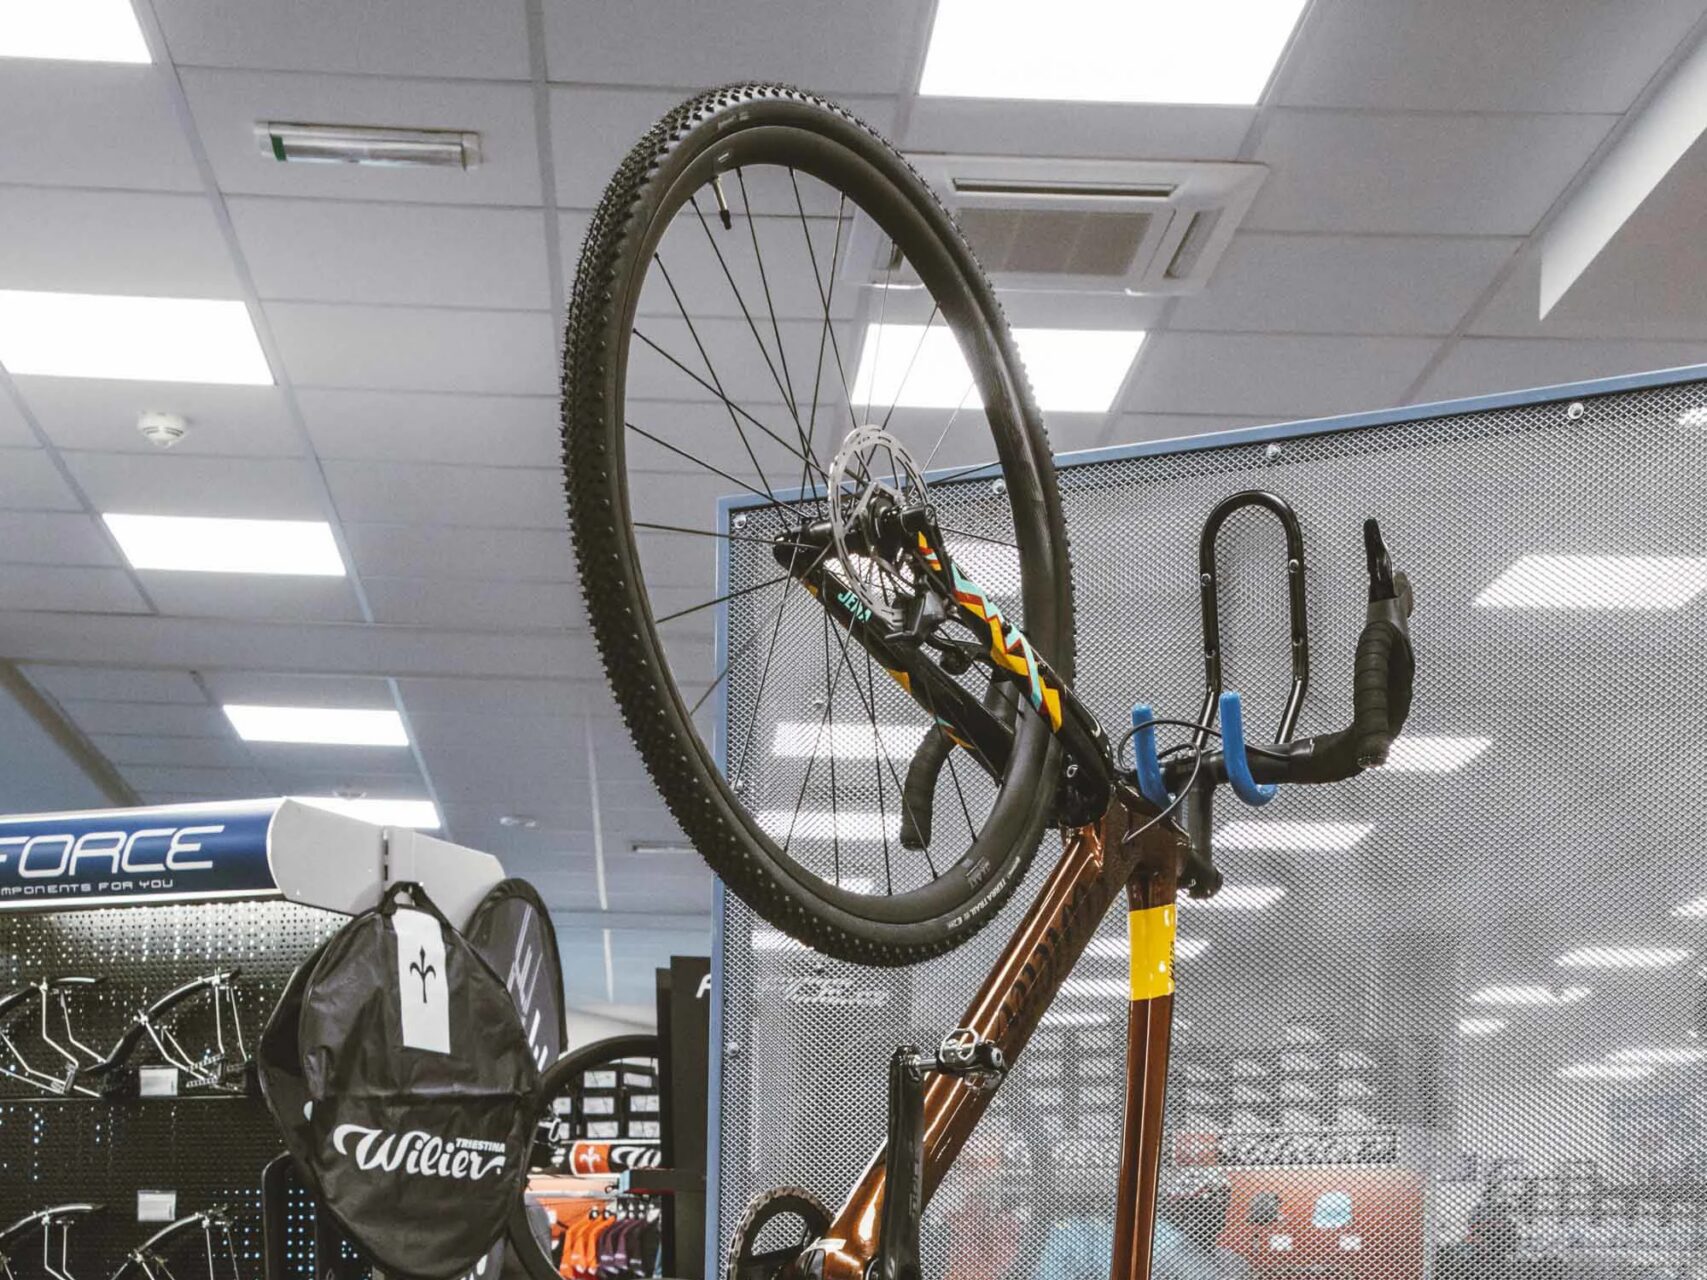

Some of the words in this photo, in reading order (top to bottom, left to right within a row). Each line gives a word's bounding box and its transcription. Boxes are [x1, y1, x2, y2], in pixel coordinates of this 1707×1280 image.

[98, 881, 133, 891] FOR
[139, 879, 174, 889] YOU
[333, 1124, 506, 1180] Wilier
[456, 1138, 506, 1153] TRIESTINA
